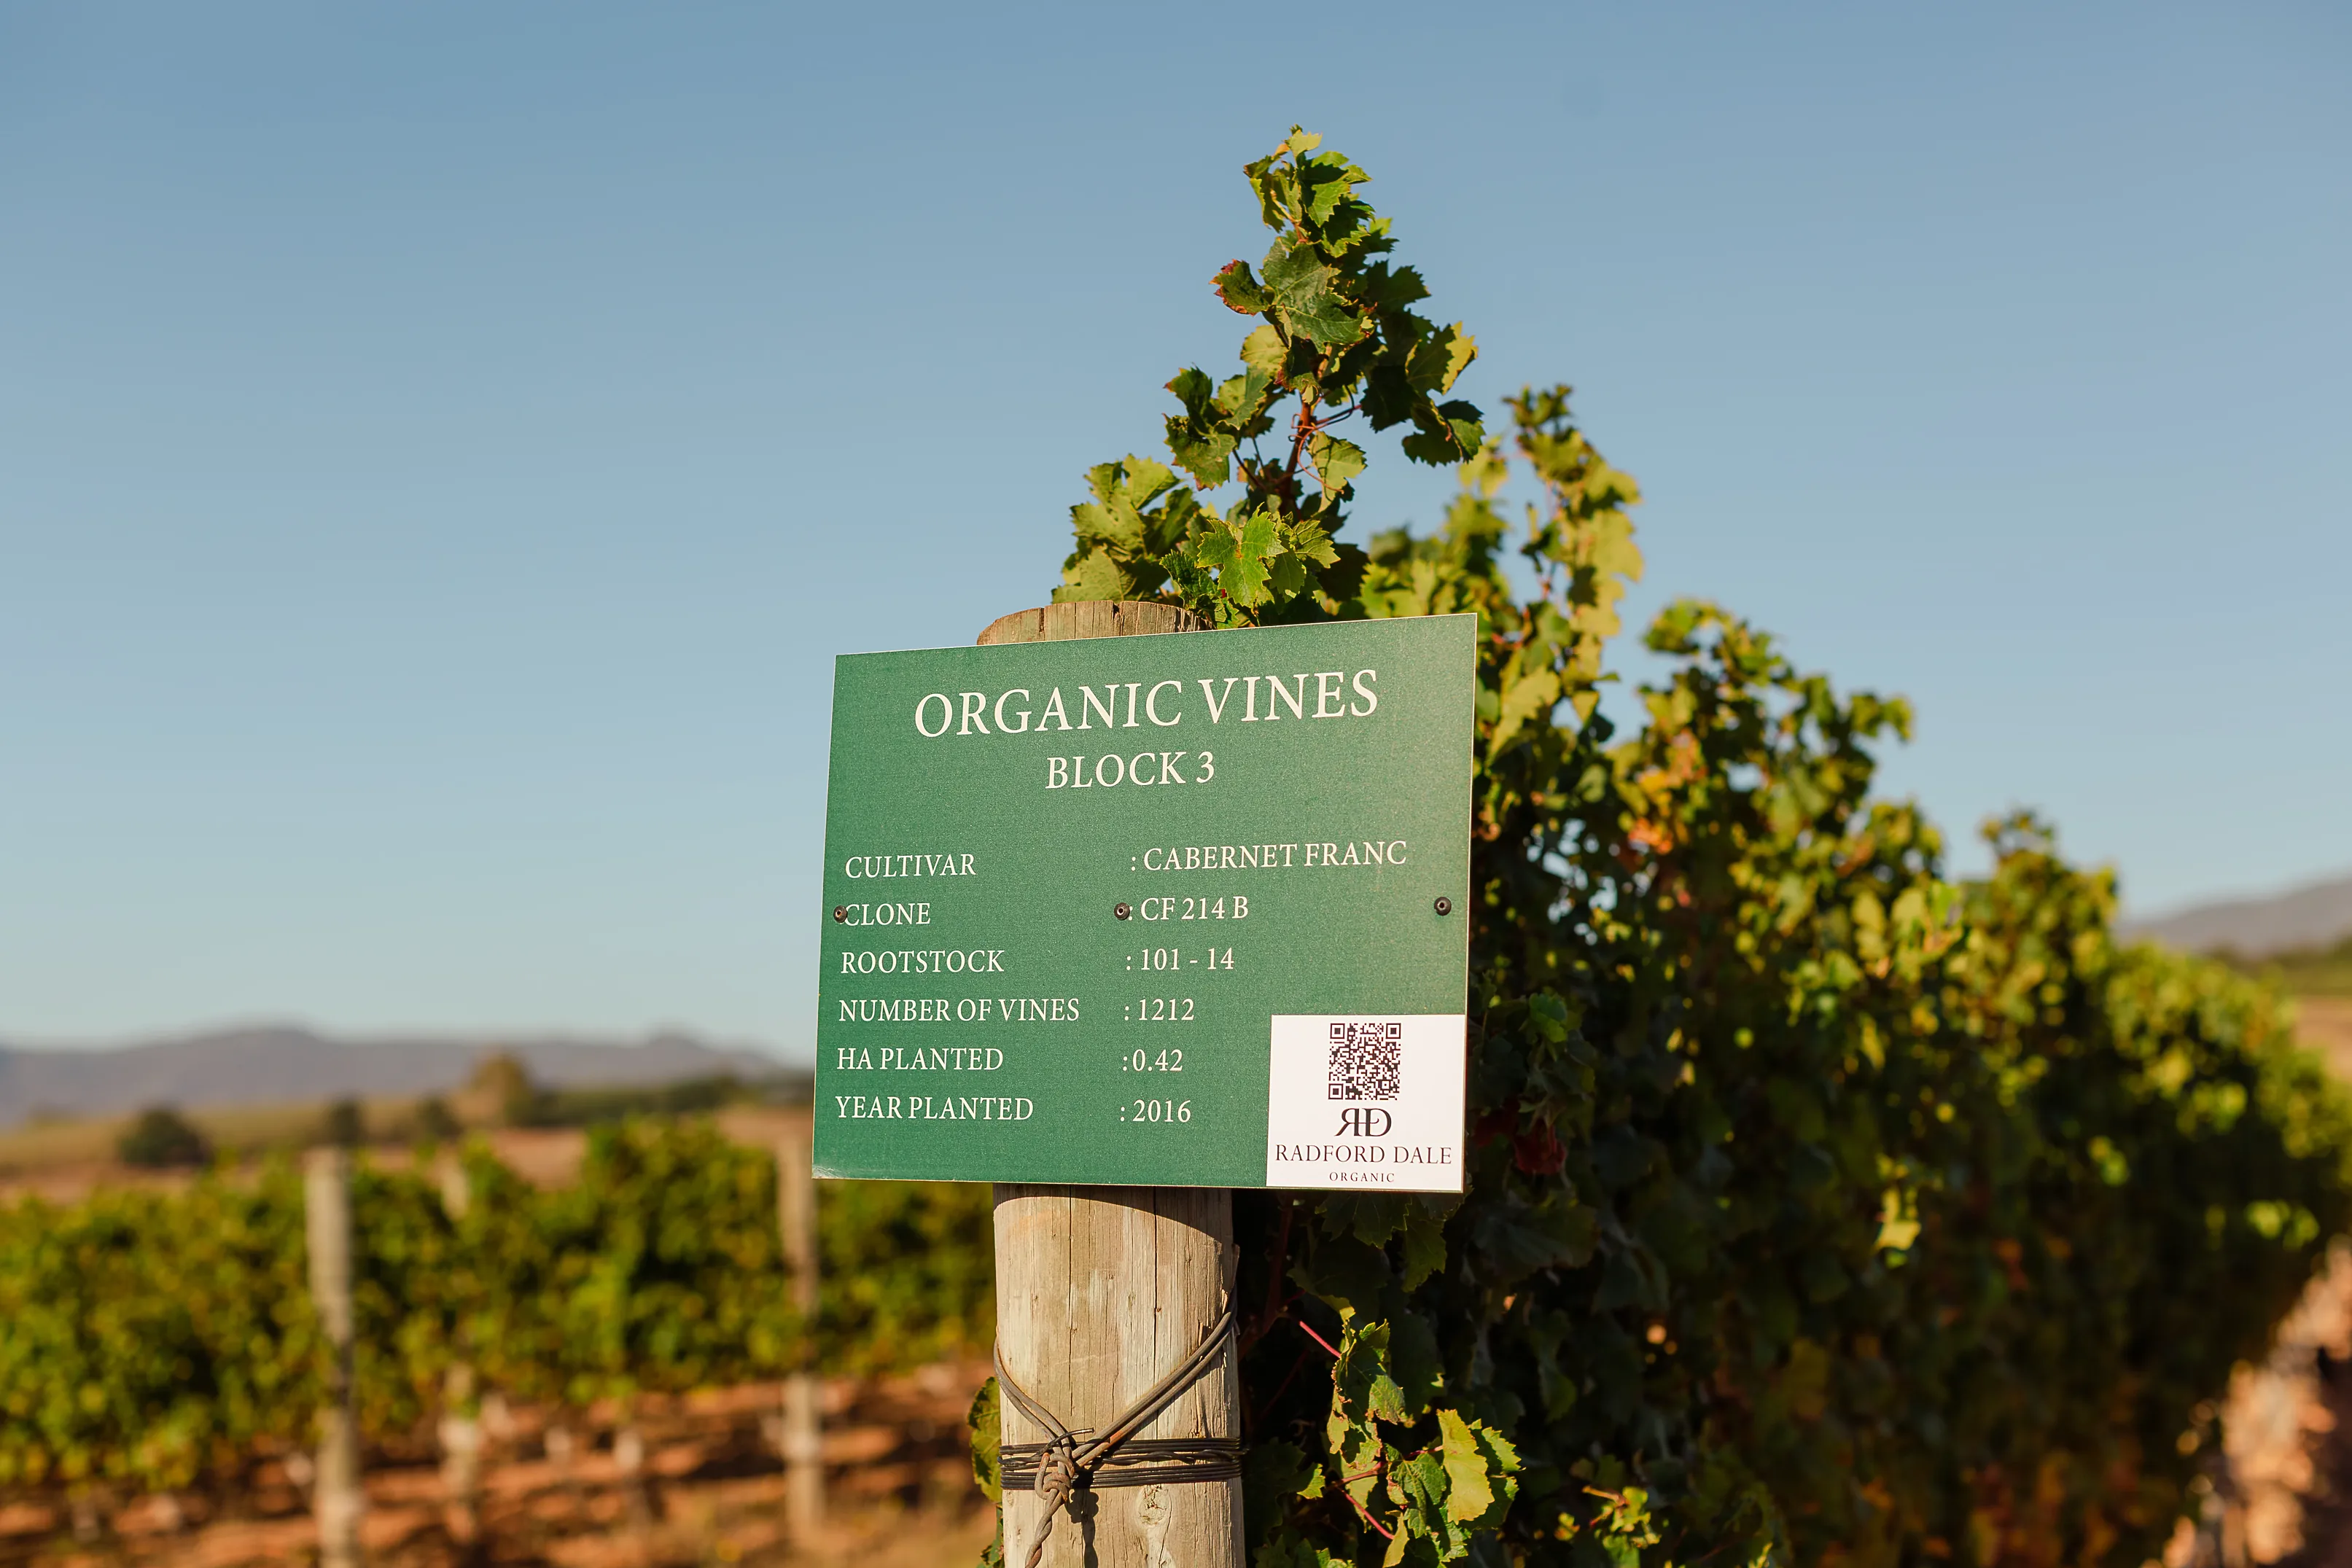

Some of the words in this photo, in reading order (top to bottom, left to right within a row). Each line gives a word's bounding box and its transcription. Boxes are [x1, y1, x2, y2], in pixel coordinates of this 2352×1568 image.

[914, 680, 1182, 738] ORGANIC
[1197, 668, 1378, 725] VINES
[1045, 751, 1187, 789] BLOCK
[1196, 751, 1215, 784] 3
[845, 854, 977, 878] CULTIVAR
[1143, 843, 1298, 871] CABERNET
[1304, 840, 1407, 867] FRANC
[845, 902, 931, 927] CLONE
[1140, 897, 1175, 921] CF
[1181, 897, 1226, 920] 214
[1231, 896, 1249, 919] B
[841, 950, 1005, 974] ROOTSTOCK
[1140, 948, 1180, 970] 101
[1207, 947, 1235, 970] 14
[838, 999, 951, 1022] NUMBER
[957, 999, 992, 1021] OF
[997, 998, 1080, 1021] VINES
[1138, 998, 1194, 1021] 1212
[836, 1048, 874, 1070] HA
[879, 1047, 1003, 1070] PLANTED
[835, 1096, 903, 1119] YEAR
[908, 1096, 1034, 1120] PLANTED
[1132, 1099, 1191, 1123] 2016
[1276, 1144, 1385, 1163] RADFORD
[1393, 1147, 1452, 1164] DALE
[1329, 1171, 1395, 1183] ORGANIC
